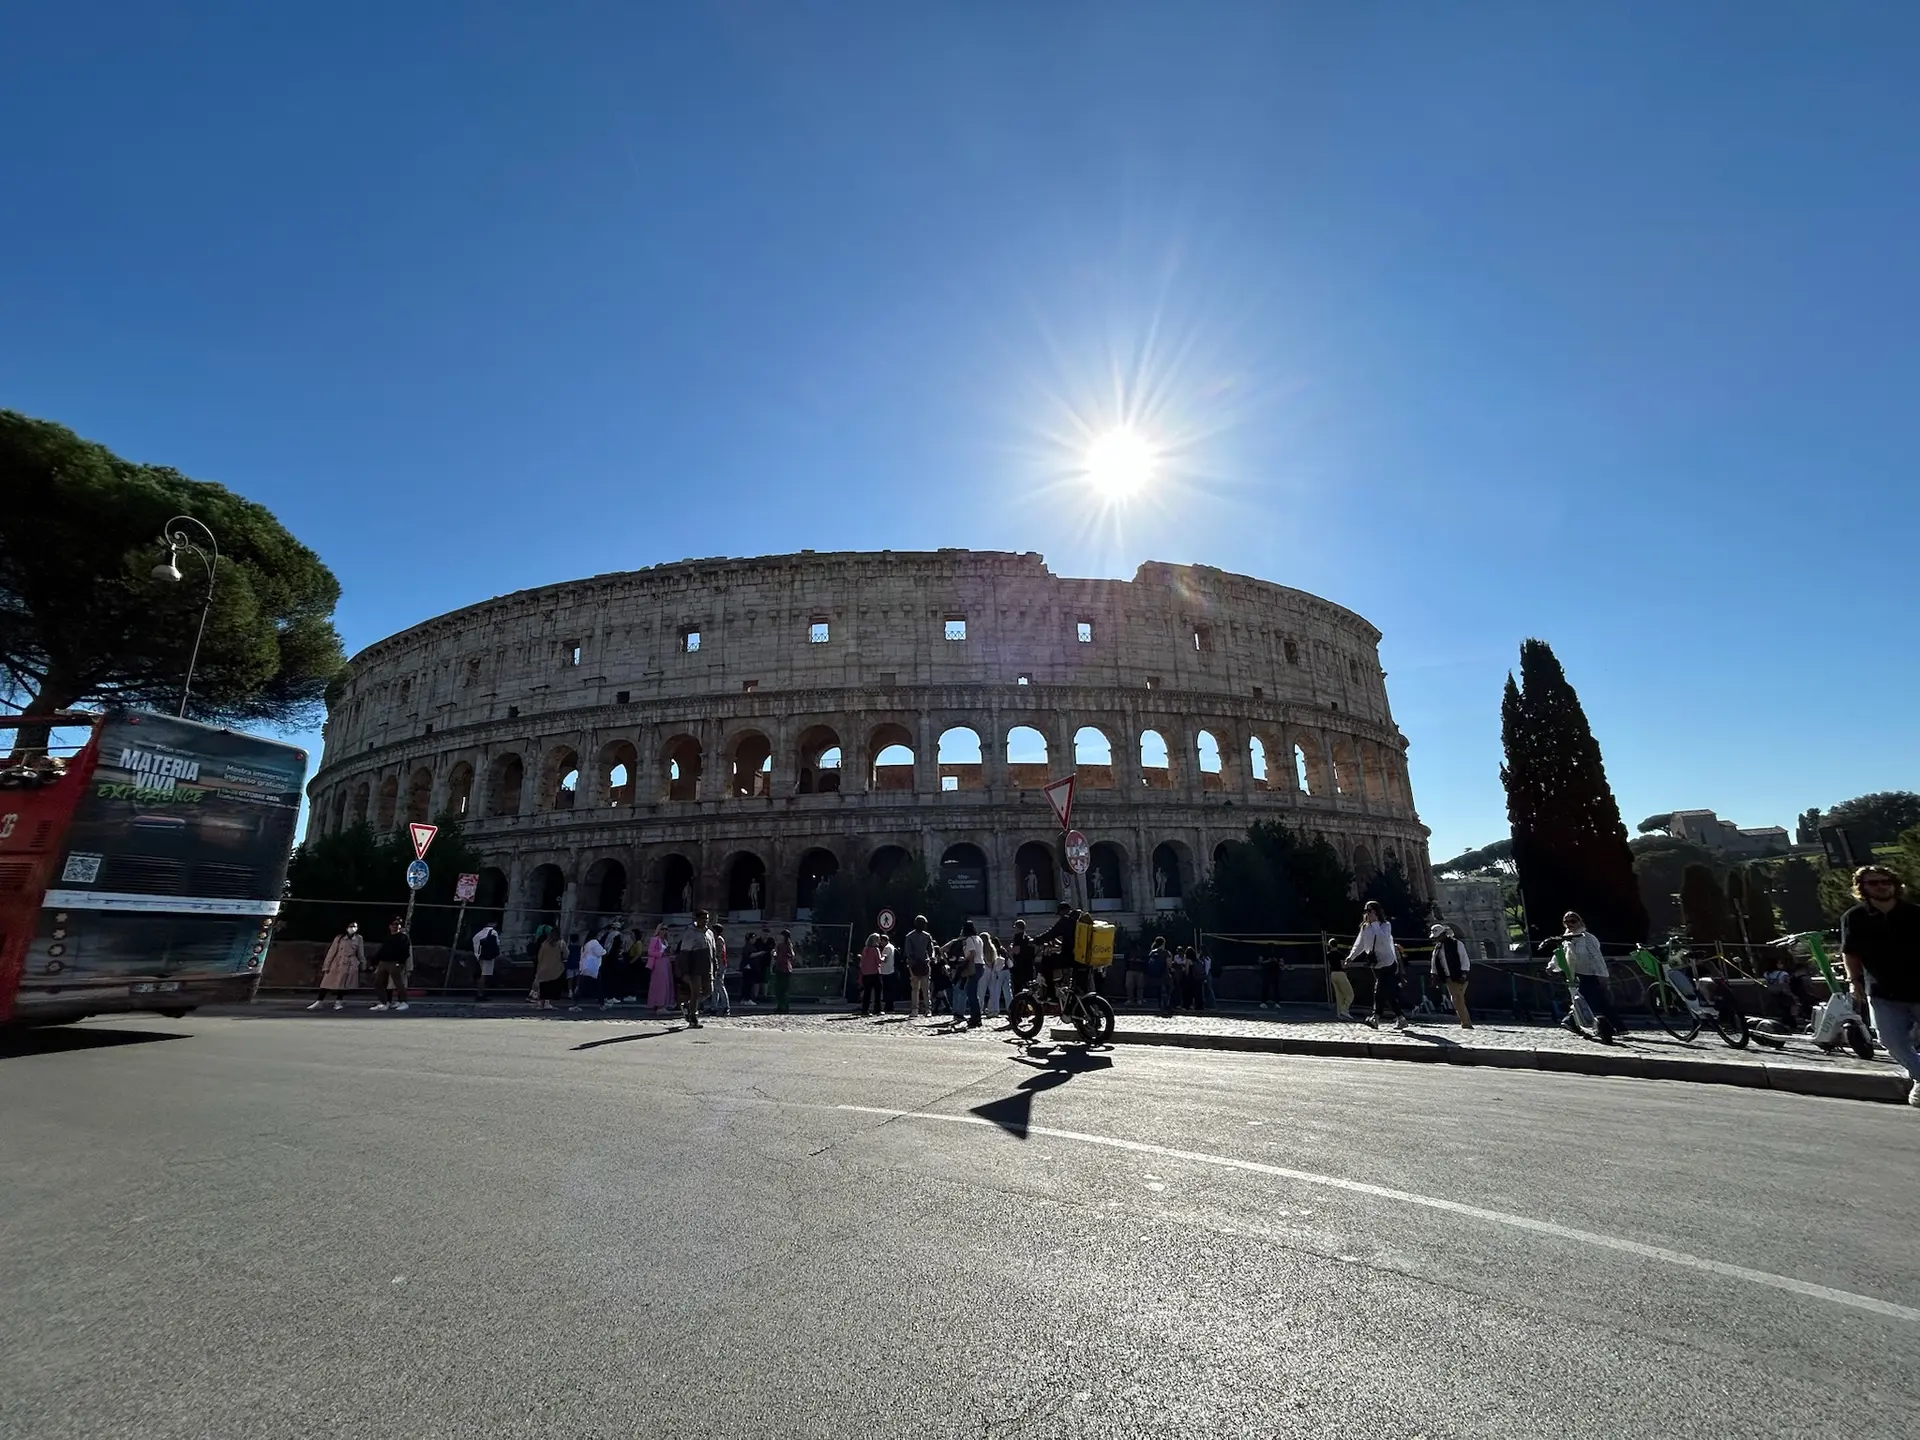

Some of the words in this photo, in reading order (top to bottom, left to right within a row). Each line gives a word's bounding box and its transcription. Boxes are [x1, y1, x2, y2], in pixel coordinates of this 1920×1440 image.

[119, 748, 200, 781] MATERIA
[226, 764, 252, 775] Mostra
[136, 771, 176, 793] VIVA
[97, 783, 205, 803] EXPERIENCE
